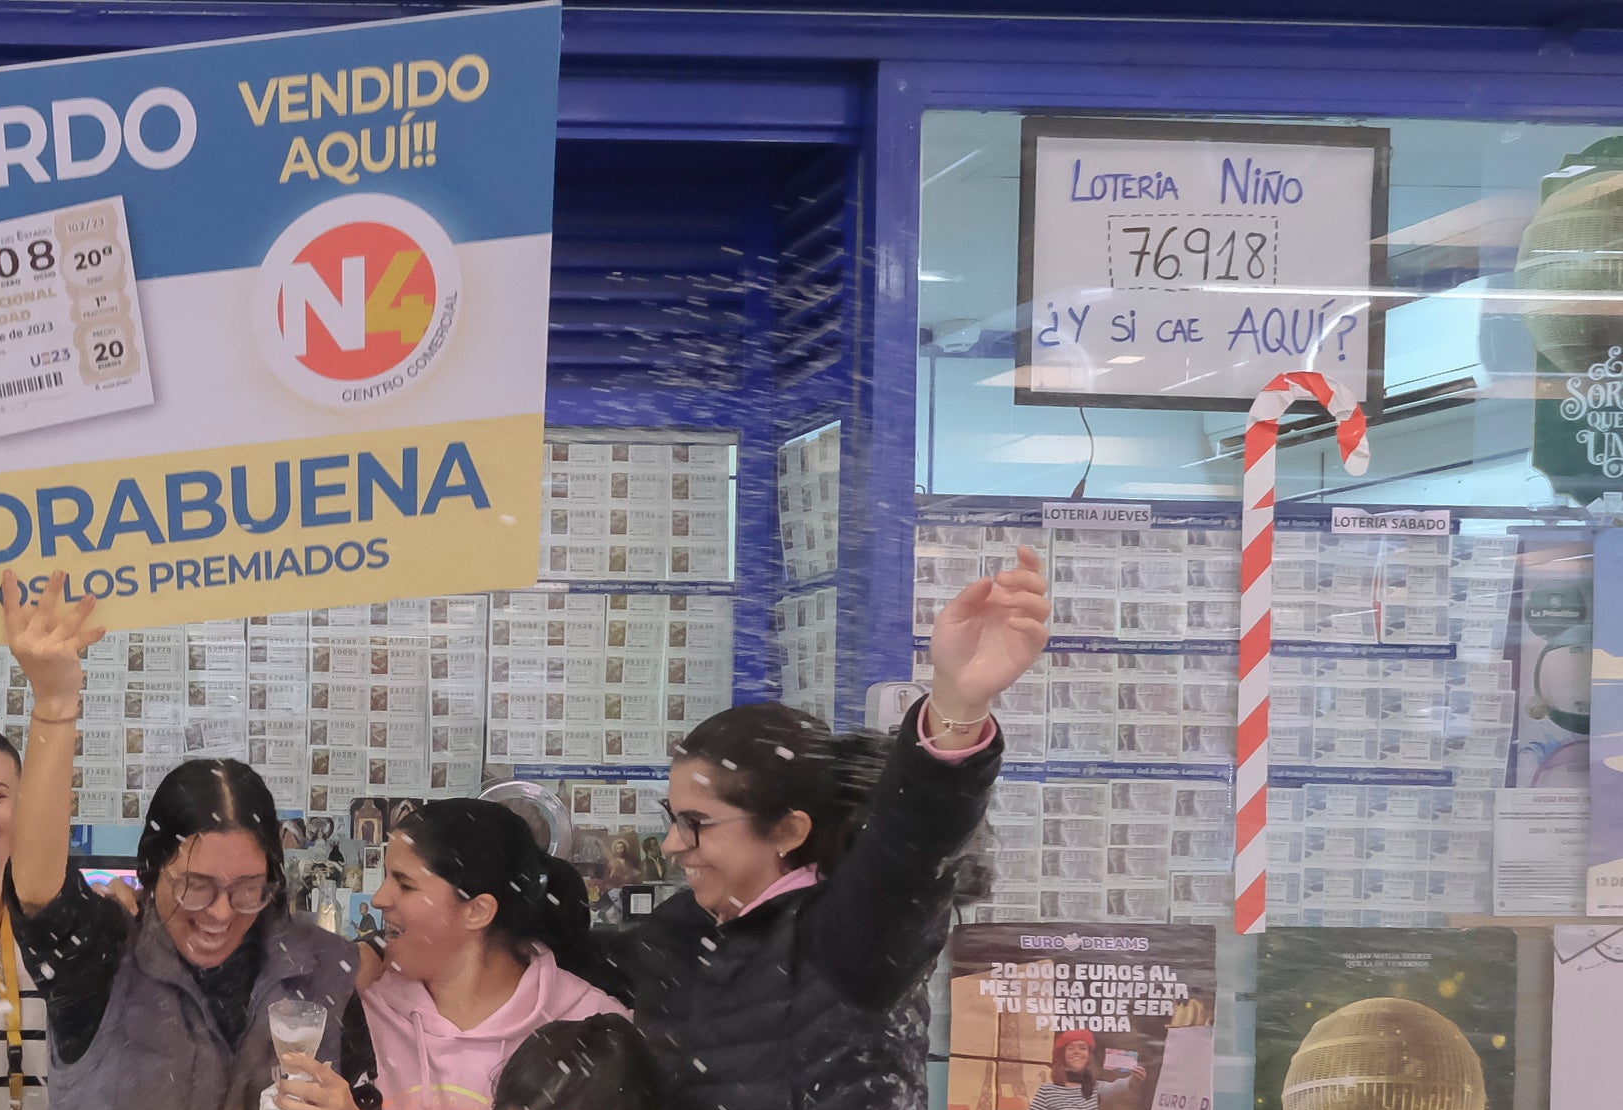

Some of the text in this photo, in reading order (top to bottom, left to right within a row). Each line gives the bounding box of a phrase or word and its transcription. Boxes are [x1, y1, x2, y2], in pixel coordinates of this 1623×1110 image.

[238, 54, 490, 125] VENDIDO
[279, 114, 437, 184] AQUÍ!!
[8, 327, 24, 340] de
[26, 321, 54, 336] 2023
[1037, 302, 1089, 347] ¿Y
[1157, 316, 1204, 343] CAE
[94, 341, 124, 363] 20
[342, 291, 457, 402] CENTRO COMERCIAL
[1044, 508, 1149, 523] LOTERIA JUEVES
[1334, 516, 1388, 529] LOTERIA
[63, 564, 139, 604] LOS
[149, 537, 390, 594] PREMIADOS
[1596, 877, 1607, 886] 13
[1020, 935, 1149, 951] EURO DREAMS
[990, 962, 1177, 982] 20.000 EUROS AL
[979, 980, 1189, 1000] MES PARA CUMPLIR
[993, 994, 1175, 1016] TU SUEÑO DE SER
[1035, 1015, 1131, 1032] PINTORA
[1159, 1093, 1186, 1110] EURO
